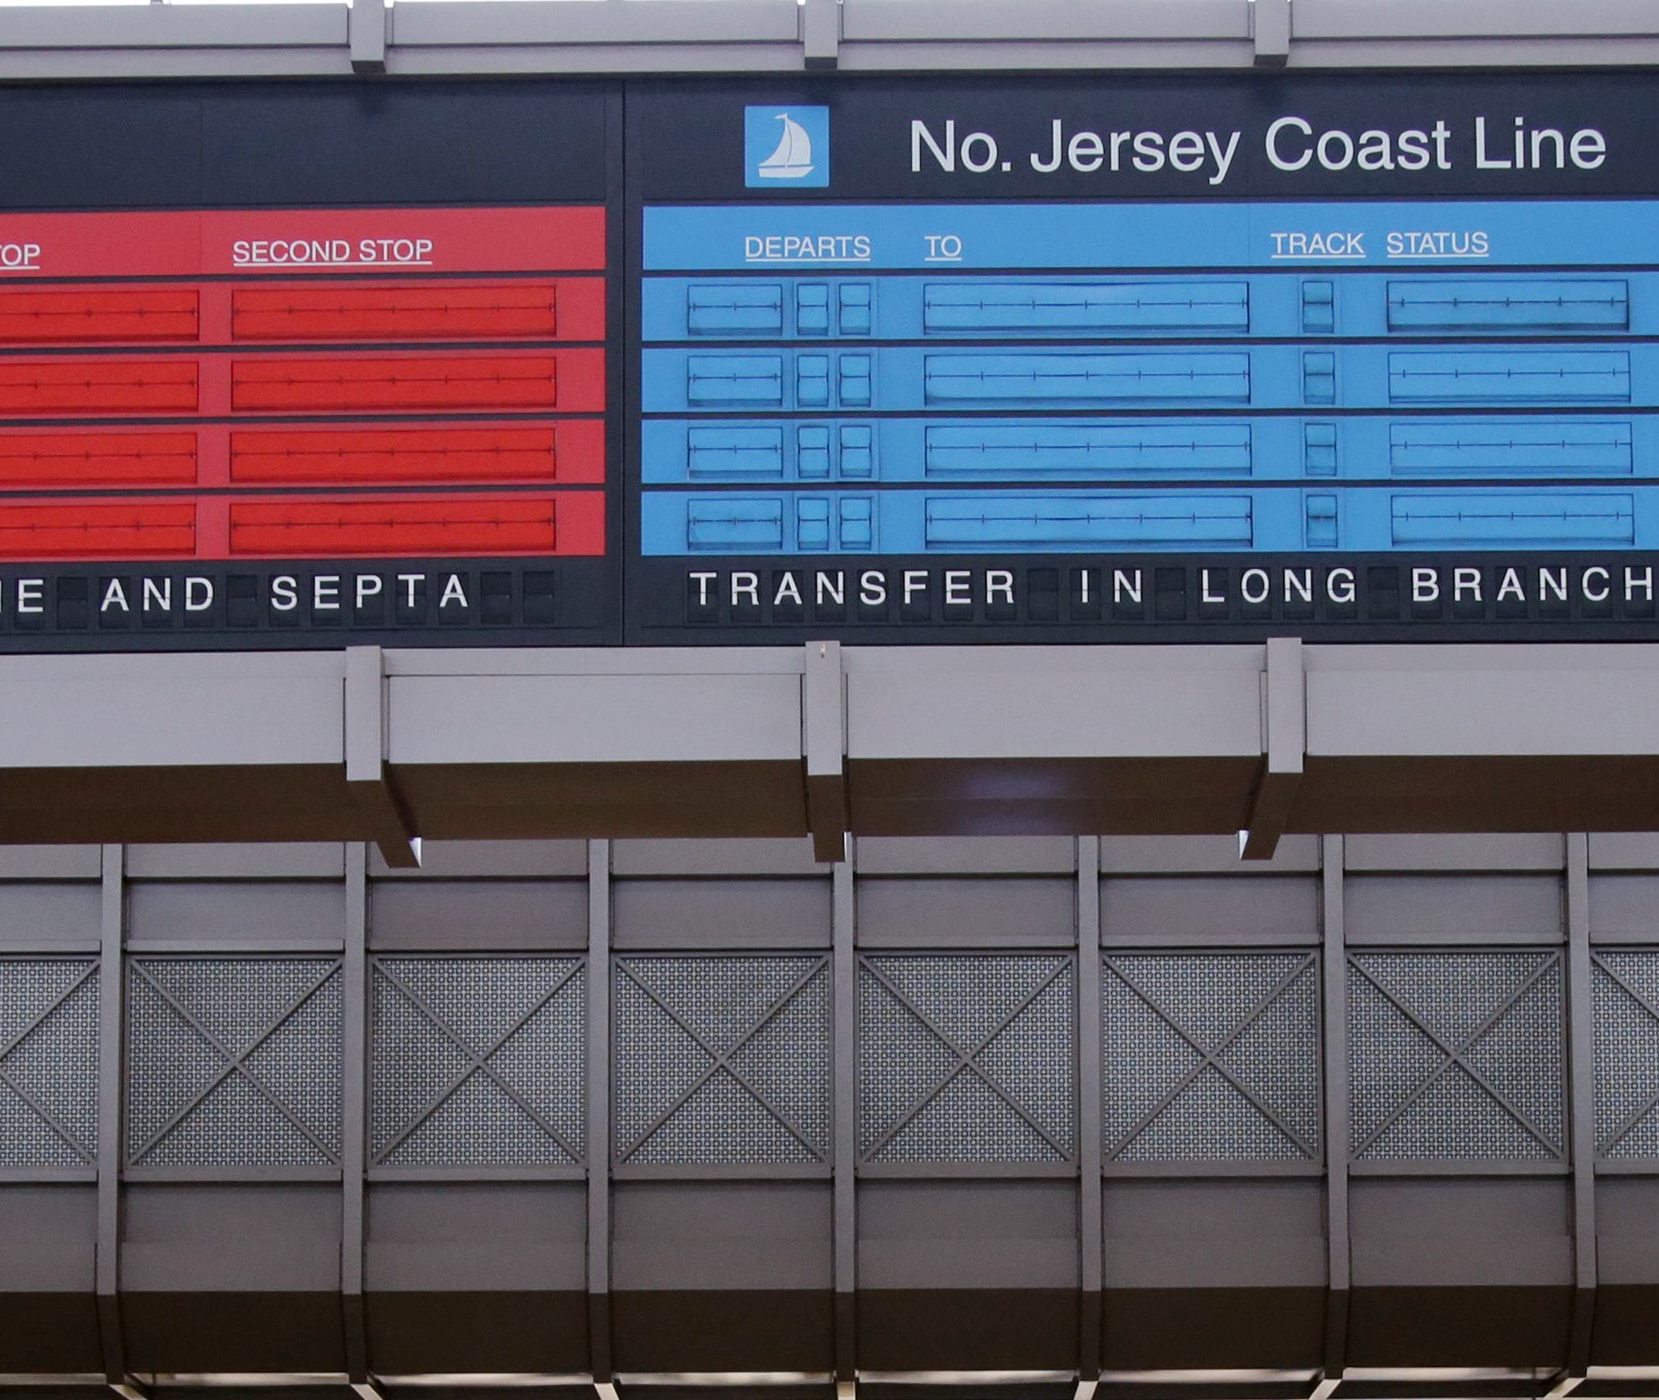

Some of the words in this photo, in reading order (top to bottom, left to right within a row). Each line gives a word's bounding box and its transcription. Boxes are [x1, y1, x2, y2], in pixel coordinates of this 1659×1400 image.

[911, 118, 1012, 174] No.
[1030, 117, 1241, 186] Jersey
[1265, 115, 1452, 172] Coast
[1475, 115, 1607, 170] Line
[232, 240, 350, 264] SECOND
[358, 239, 433, 263] STOP
[745, 235, 871, 258] DEPARTS
[924, 235, 962, 257] TO
[1270, 233, 1366, 255] TRACK
[1386, 232, 1489, 255] STATUS
[100, 577, 215, 612] AND
[271, 574, 469, 611] SEPTA
[689, 571, 1015, 606] TRANSFER
[1081, 569, 1142, 603] IN
[1202, 568, 1356, 604] LONG
[1412, 566, 1654, 602] BRANCH
